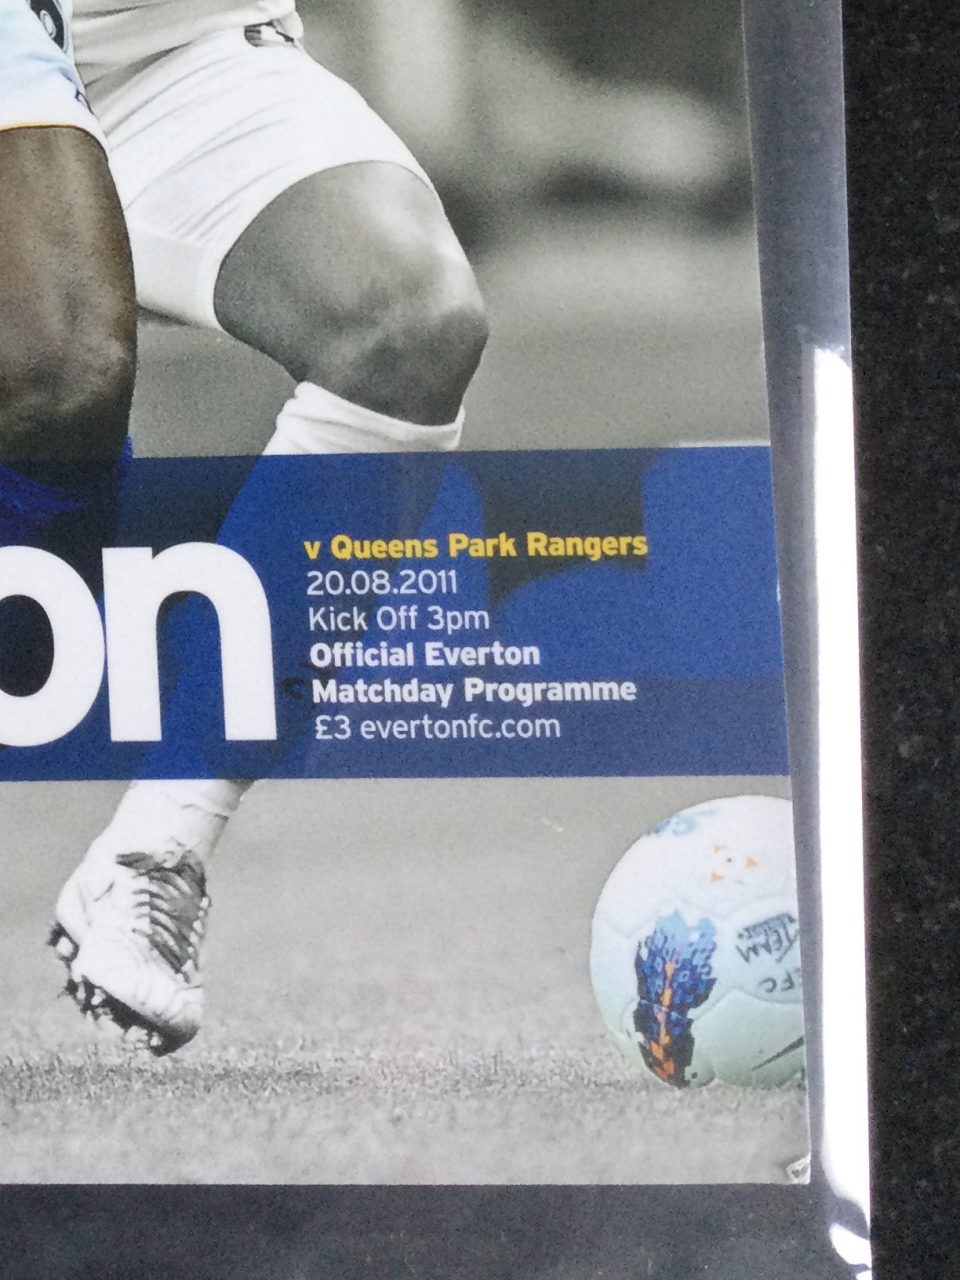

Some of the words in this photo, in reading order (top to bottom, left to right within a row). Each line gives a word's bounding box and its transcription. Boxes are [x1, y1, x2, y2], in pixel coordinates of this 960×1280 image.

[304, 540, 321, 559] v
[331, 534, 438, 560] Queens
[449, 533, 517, 558] Park
[527, 531, 649, 561] Rangers
[306, 569, 458, 596] 20.08.2011
[308, 606, 368, 631] Kick
[376, 605, 418, 630] Off
[427, 605, 490, 635] 3pm
[310, 641, 414, 668] Official
[425, 641, 540, 667] Everton
[312, 677, 454, 708] Matchday
[464, 677, 638, 708] Programme
[315, 714, 351, 740] £3
[360, 713, 561, 740] evertonfc.com
